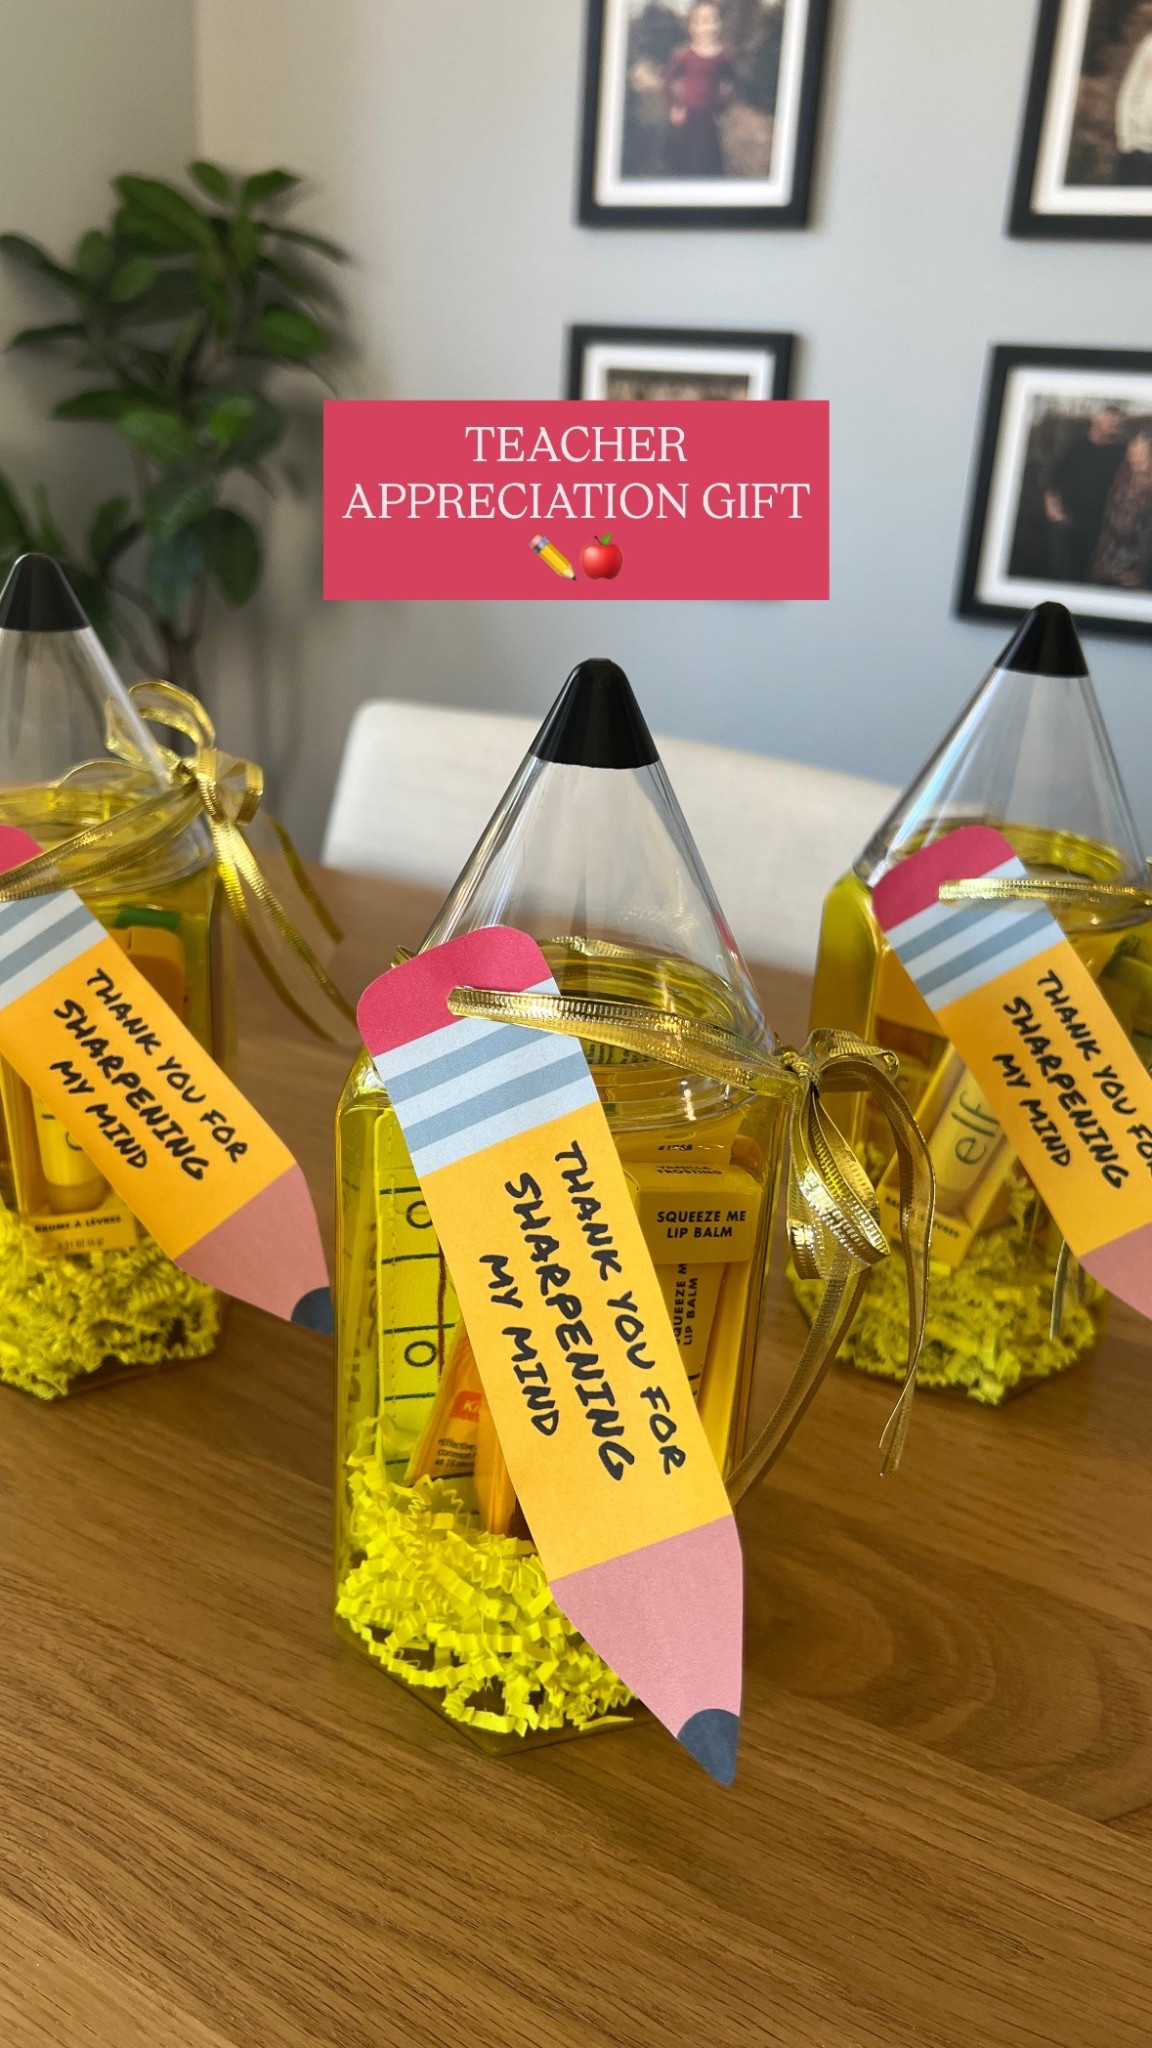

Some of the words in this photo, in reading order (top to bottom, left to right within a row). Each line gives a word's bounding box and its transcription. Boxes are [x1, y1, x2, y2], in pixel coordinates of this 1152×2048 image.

[49, 1061, 95, 1094] MY
[84, 1103, 147, 1169] MIND
[53, 999, 209, 1180] SHARPENING
[86, 968, 161, 1055] THANK
[156, 1054, 205, 1103] YOU
[200, 1109, 247, 1163] FOR
[992, 1053, 1032, 1088] MY
[1019, 1099, 1071, 1167] MIND
[1002, 996, 1129, 1189] SHARPENING
[1037, 970, 1101, 1061] THANK
[1092, 1065, 1137, 1115] YOU
[1127, 1124, 1152, 1172] FO
[656, 1210, 720, 1223] SQUEEZE
[726, 1210, 747, 1222] ME
[666, 1227, 688, 1239] LIP
[693, 1226, 733, 1238] BALM
[479, 1254, 524, 1309] MY
[504, 1172, 635, 1481] SHARPENING
[554, 1140, 622, 1281] THANK
[606, 1291, 656, 1370] YOU
[639, 1386, 686, 1475] FOR
[683, 1325, 694, 1346] LIP
[686, 1277, 699, 1319] BALM
[501, 1326, 559, 1436] MIND
